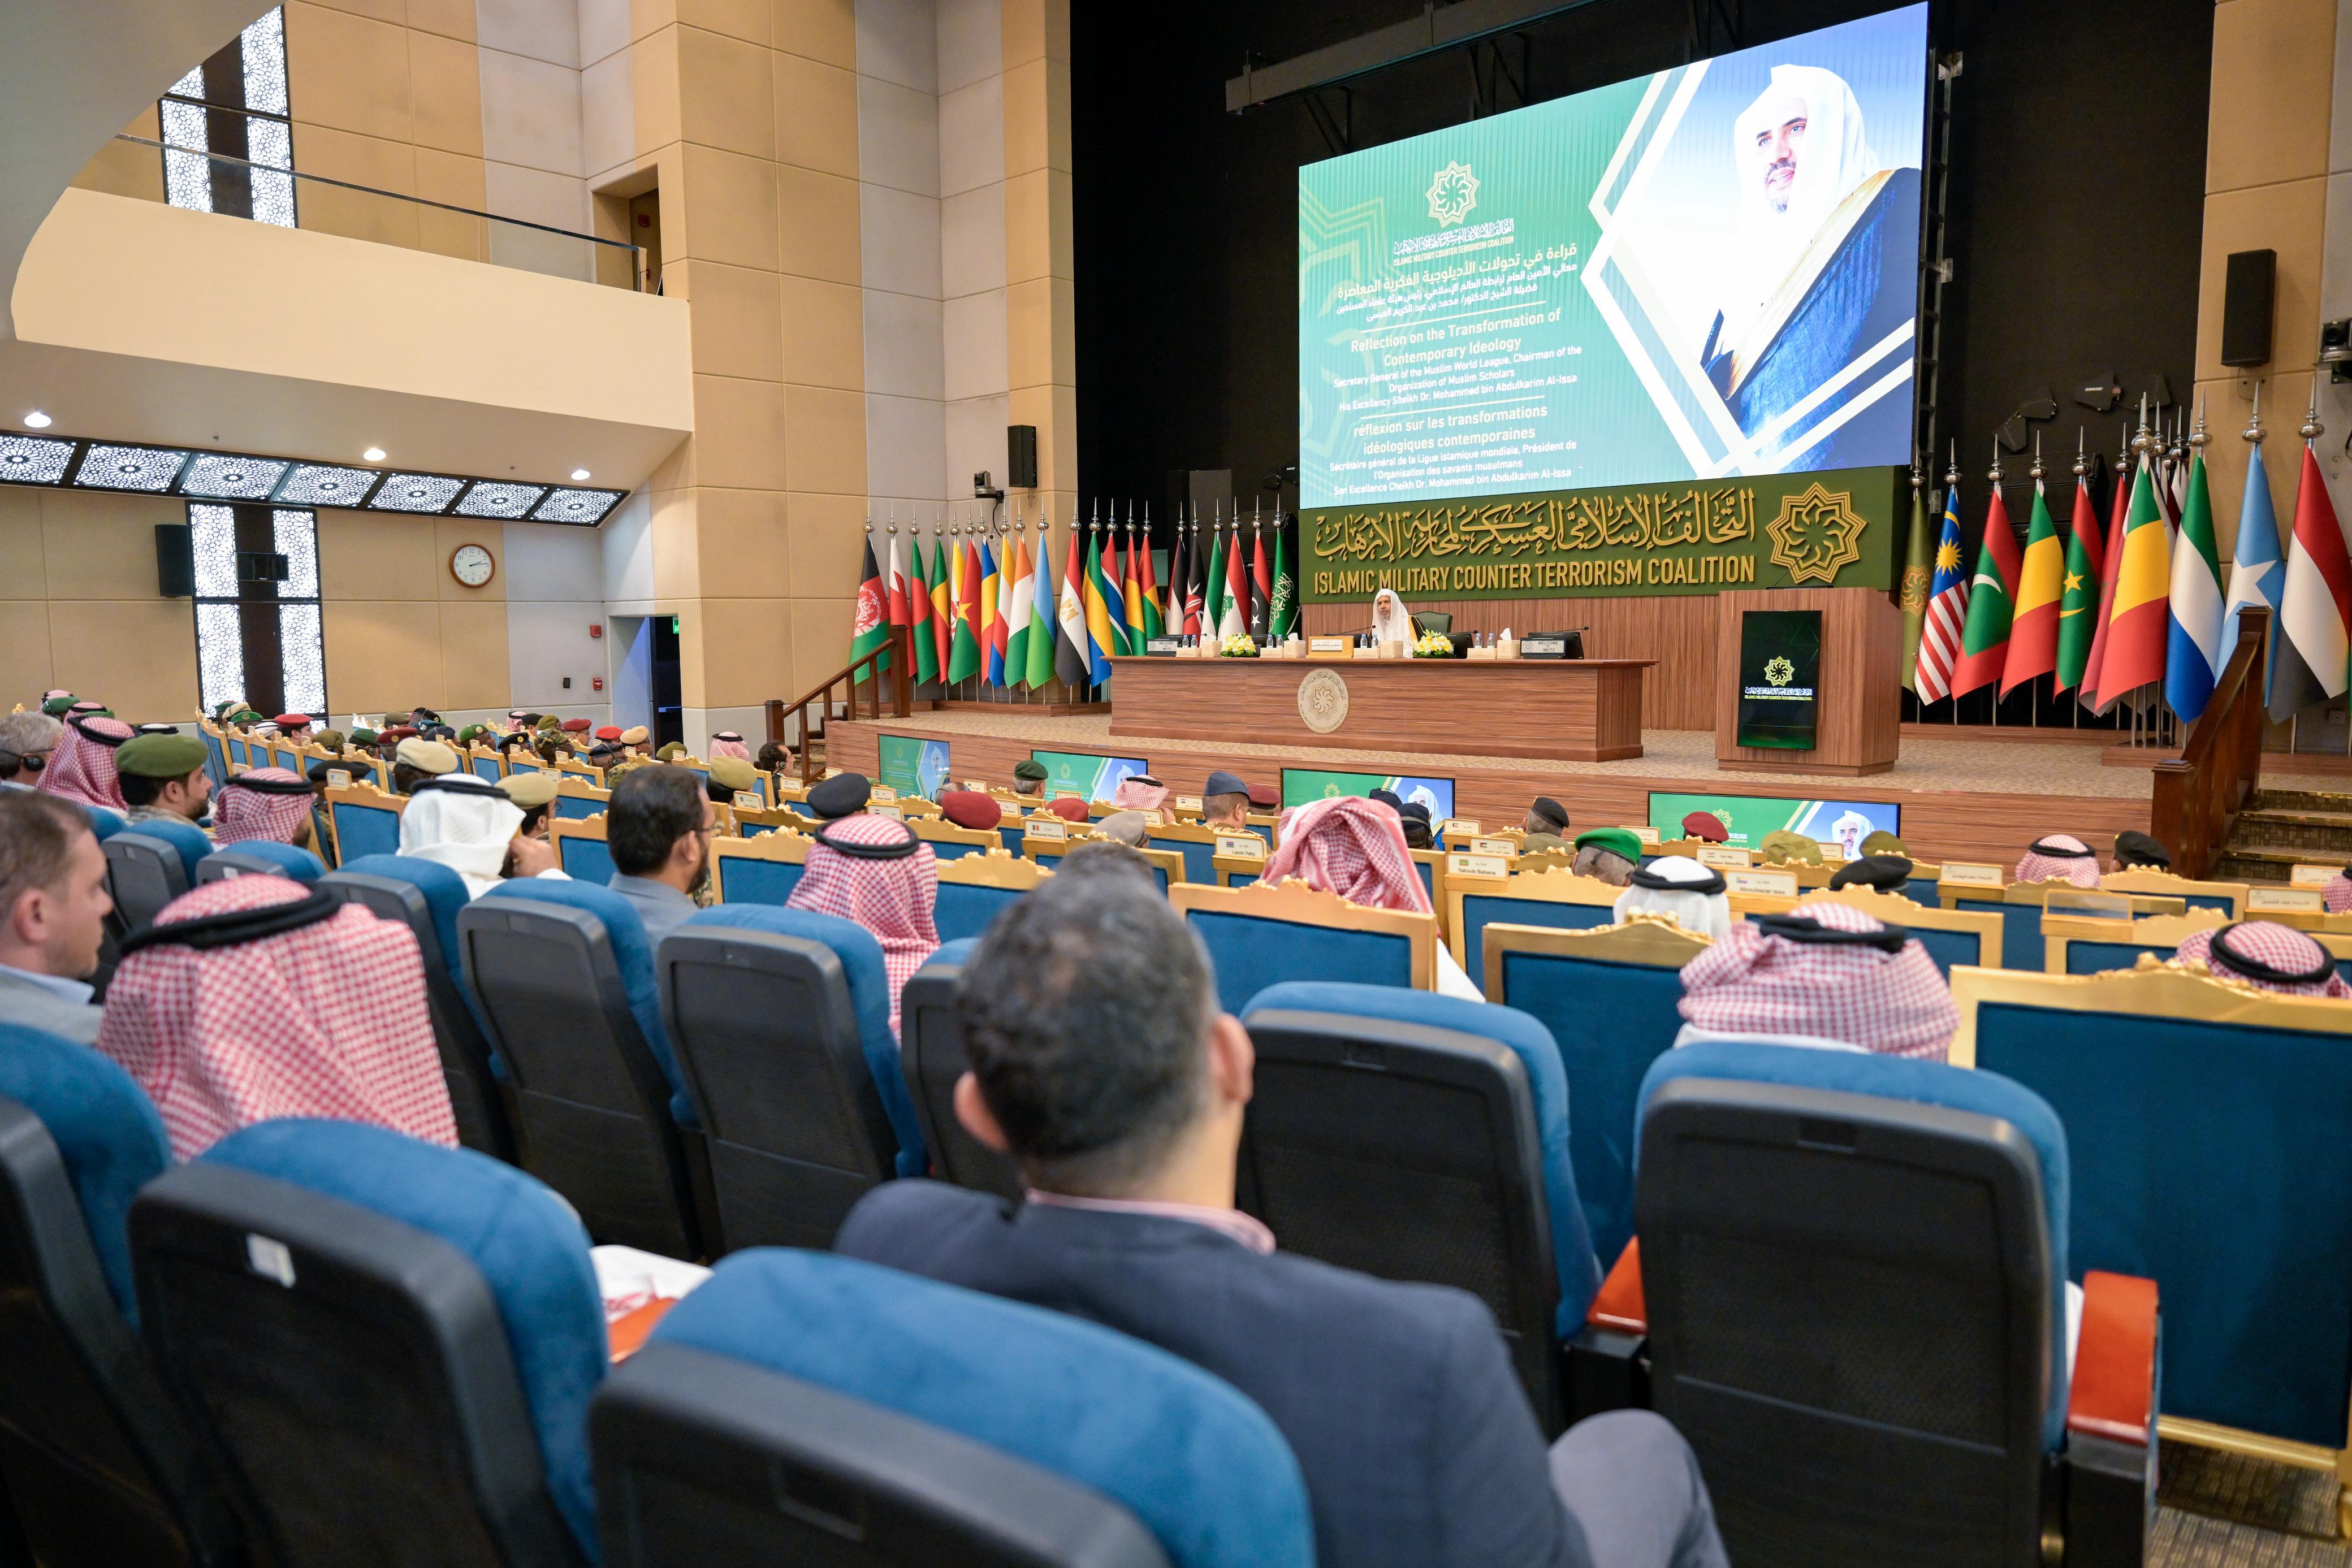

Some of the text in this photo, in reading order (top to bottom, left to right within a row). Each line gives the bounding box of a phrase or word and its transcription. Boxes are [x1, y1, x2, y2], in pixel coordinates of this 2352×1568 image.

[1394, 236, 1514, 266] ISLAMIC MILITARY COUNTER TERRORISM COALITION
[1338, 243, 1577, 301] قراءة في تحولات الأديلوجية الفكرية المعاصرة
[1507, 270, 1525, 284] العام
[1527, 265, 1550, 281] الأمين
[1553, 263, 1577, 278] معالي
[1460, 279, 1480, 292] العالم
[1483, 274, 1504, 287] لرابطة
[1404, 289, 1422, 303] رئيس
[1490, 287, 1512, 301] الشيخ
[1514, 283, 1538, 295] فضيلة
[1368, 297, 1385, 307] علماء
[1388, 293, 1403, 304] هيئة
[1438, 298, 1458, 308] محمد
[1337, 299, 1367, 315] المسلمين
[1366, 307, 1391, 322] العيسى
[1393, 304, 1412, 318] الكريم
[1414, 304, 1426, 313] عبد
[1428, 302, 1436, 312] بن
[1351, 307, 1561, 353] Reflection on the Transformation of
[1384, 337, 1522, 366] Contemporary Ideology
[1334, 345, 1582, 388] Secretary General of the Muslim World League, Chairman of the
[1389, 369, 1515, 393] Organization of Muslim Scholars
[1339, 374, 1577, 412] His Excellency Sheikh Dr. Mohammed bin Abdulkarim Al-Issa
[1354, 406, 1547, 437] réflexion sur les transformations
[1364, 427, 1536, 454] idéologiques contemporaines
[1330, 440, 1577, 472] Secrétaire général de la Ligue islamique mondiale, Président de
[1426, 466, 1441, 475] des
[1443, 464, 1473, 474] savants
[1475, 460, 1523, 471] musulmans
[1334, 469, 1571, 496] Son Excellence Cheikh Dr. Mohammed bin Abdulkarim Al-Issa
[1315, 555, 1754, 594] ISLAMIC MILITARY COUNTER TERRORISM COALITION
